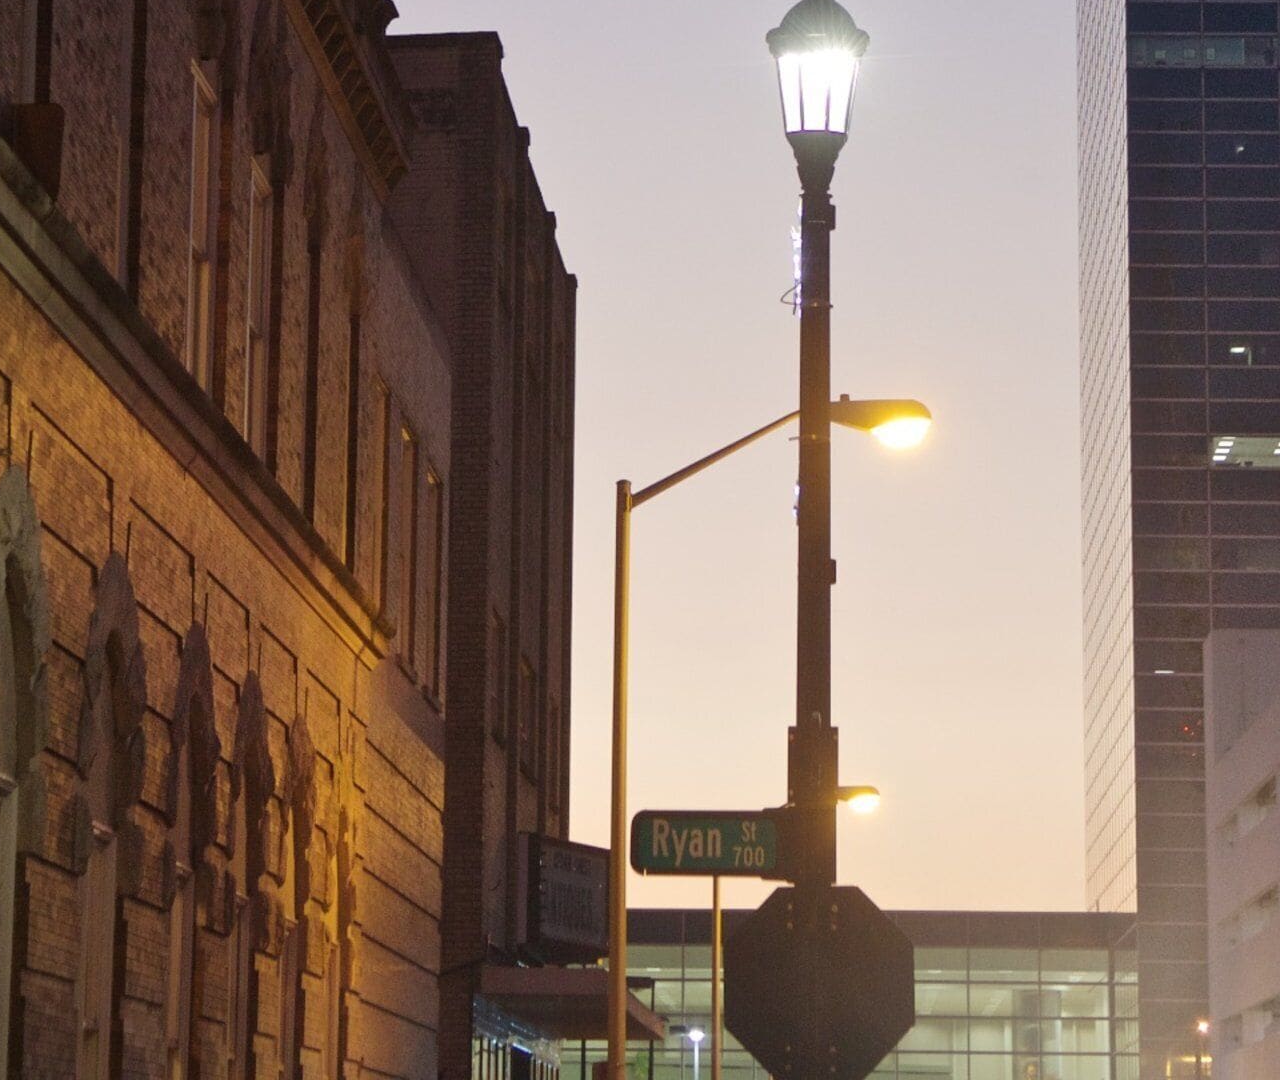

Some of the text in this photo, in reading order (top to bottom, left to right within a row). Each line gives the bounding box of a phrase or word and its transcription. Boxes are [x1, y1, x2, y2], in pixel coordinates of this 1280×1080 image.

[652, 818, 757, 867] Ryan St
[733, 846, 765, 867] 700
